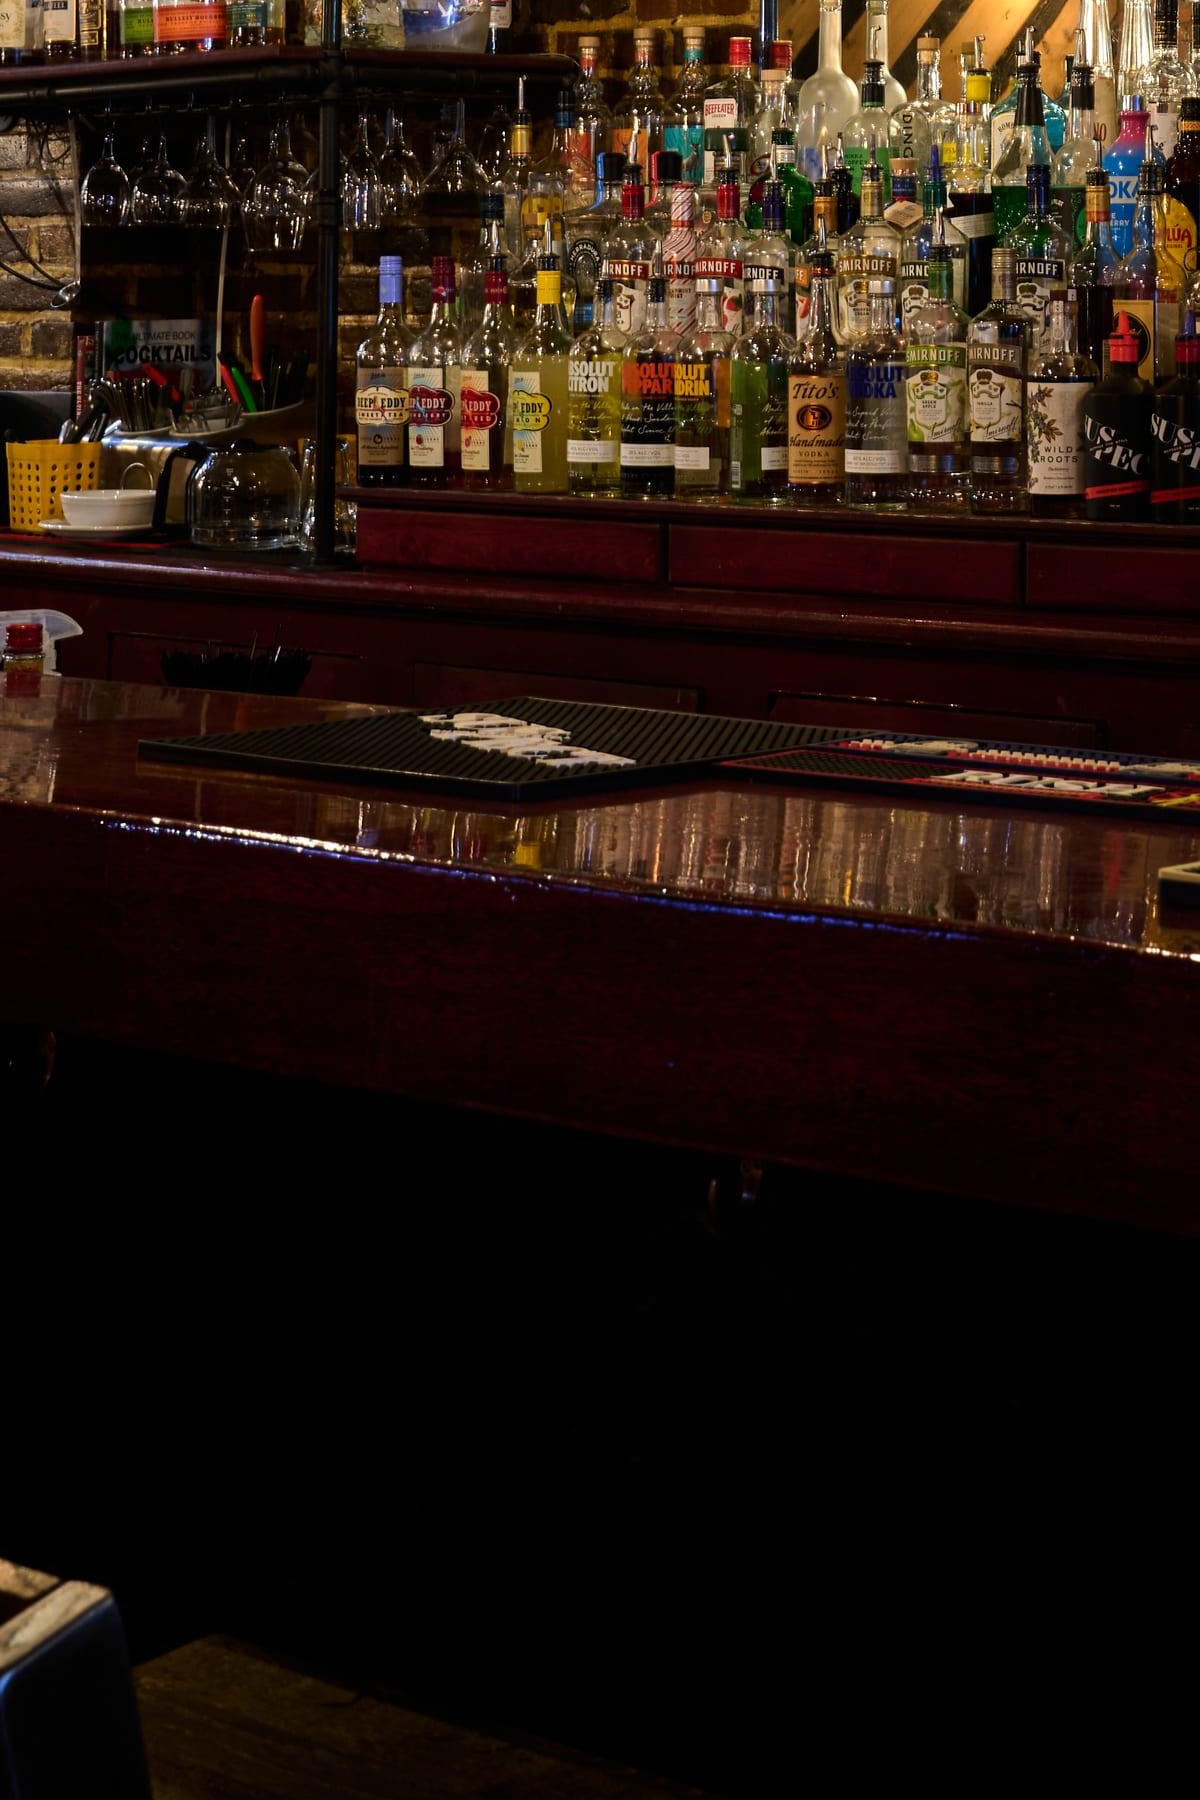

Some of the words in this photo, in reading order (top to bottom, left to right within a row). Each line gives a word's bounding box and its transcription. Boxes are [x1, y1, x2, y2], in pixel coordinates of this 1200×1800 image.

[704, 103, 735, 116] BEEFEATER
[902, 114, 914, 159] DING
[607, 262, 644, 277] RNOFF
[696, 259, 737, 274] IRNOFF
[839, 257, 892, 274] SMIRNOFF
[1015, 259, 1060, 276] IRNOFF
[172, 331, 196, 340] BOOK
[905, 350, 961, 363] SMIRNOFF
[568, 360, 616, 377] BSOLUT
[674, 363, 708, 380] OLUT
[568, 376, 609, 393] ITRON
[674, 379, 711, 397] DRIN
[792, 382, 840, 400] Tito's
[381, 396, 406, 409] EDDY
[421, 397, 446, 409] EDDY
[468, 400, 492, 413] EDDY
[520, 401, 544, 414] EDDY
[1084, 414, 1117, 443] US
[1040, 455, 1079, 464] ROOTS
